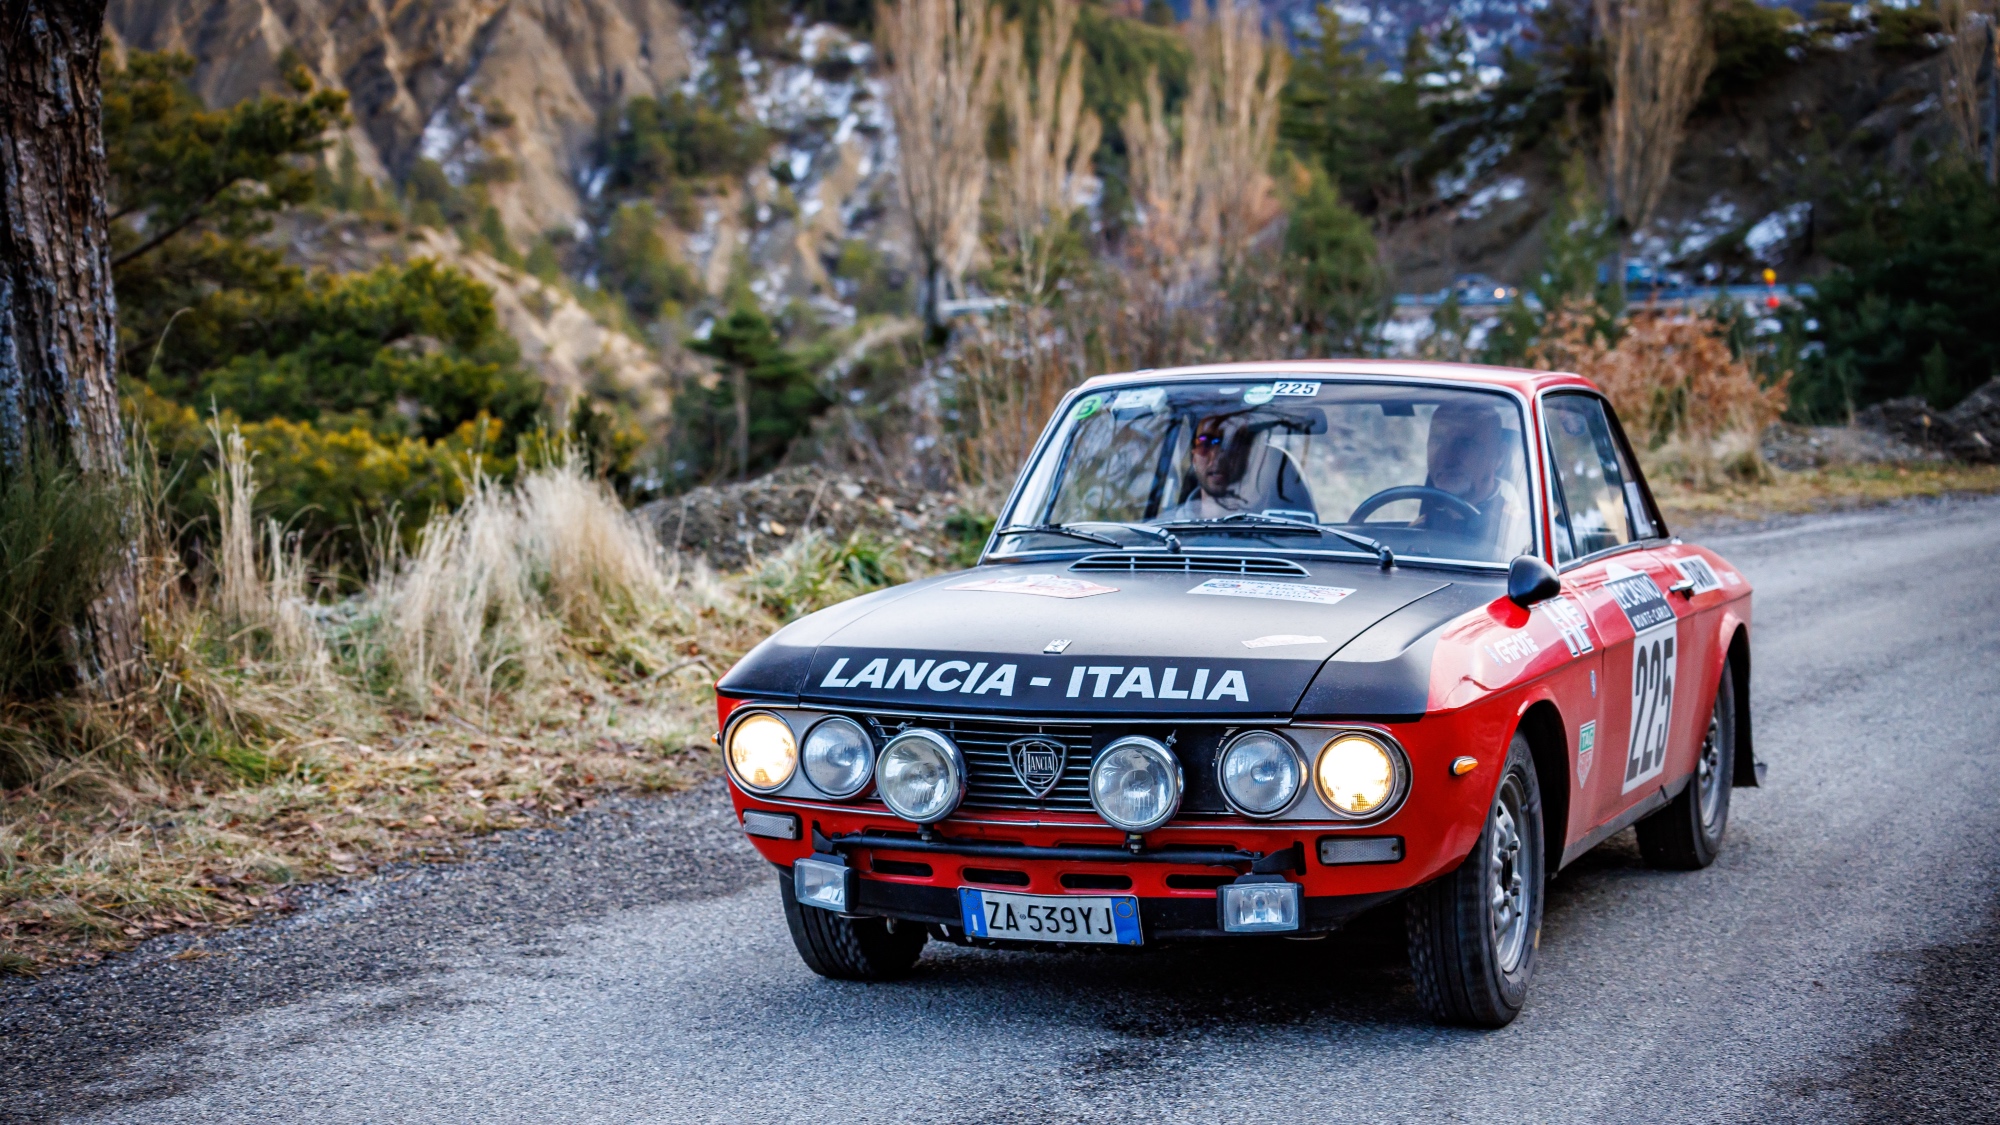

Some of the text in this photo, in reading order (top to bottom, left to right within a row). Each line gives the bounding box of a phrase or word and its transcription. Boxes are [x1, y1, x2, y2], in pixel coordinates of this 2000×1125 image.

[1276, 383, 1315, 395] 225
[1077, 399, 1097, 417] B
[820, 657, 1018, 697] LANCIA
[1066, 665, 1250, 702] ITALIA
[1625, 637, 1674, 782] 225
[1027, 753, 1053, 773] LANCIA
